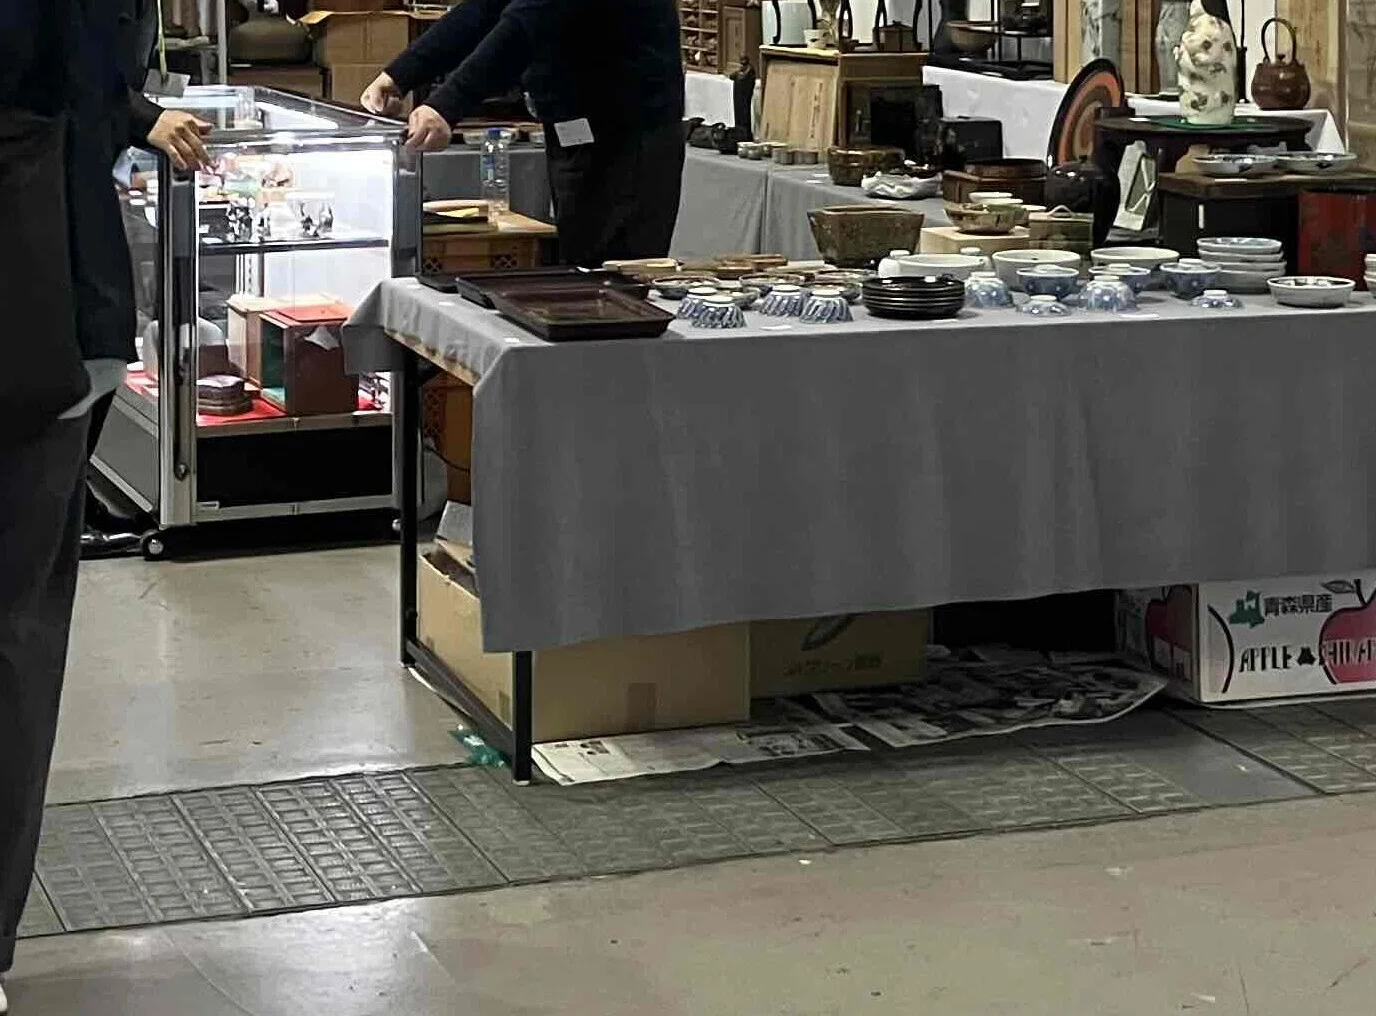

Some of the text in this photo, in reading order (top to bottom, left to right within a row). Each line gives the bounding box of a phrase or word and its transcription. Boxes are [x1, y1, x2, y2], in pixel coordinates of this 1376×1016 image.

[1263, 593, 1334, 617] 青森県産
[1239, 644, 1292, 673] APPLE
